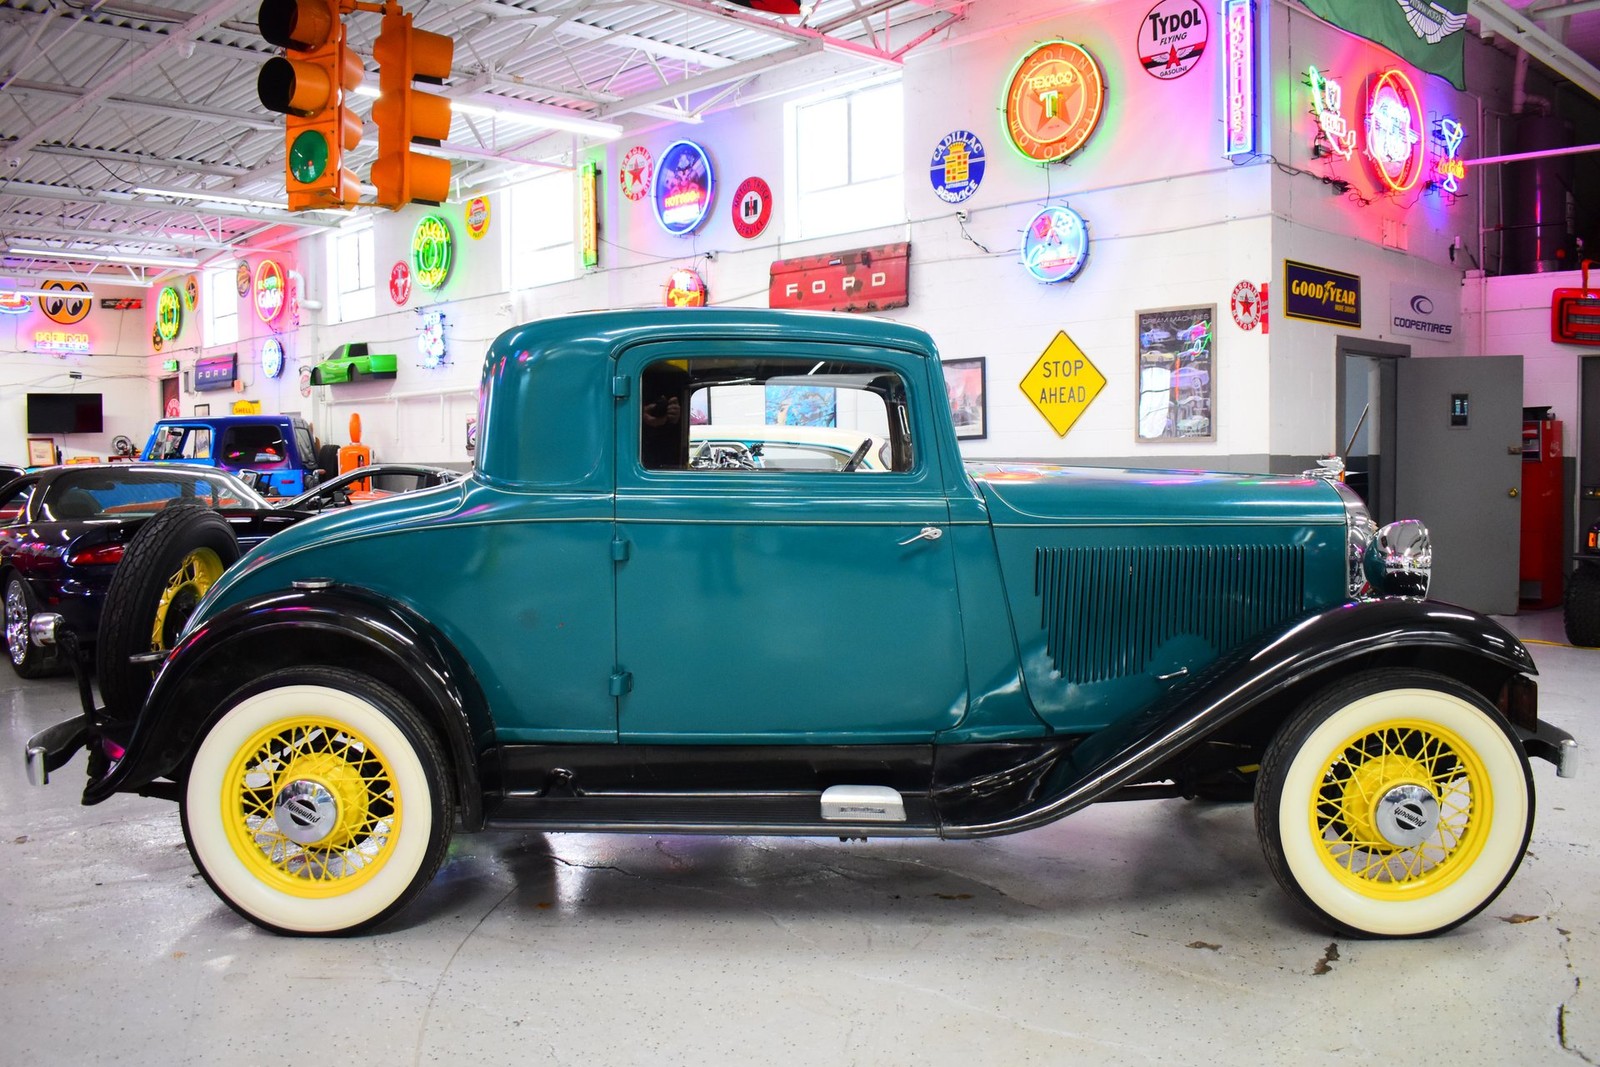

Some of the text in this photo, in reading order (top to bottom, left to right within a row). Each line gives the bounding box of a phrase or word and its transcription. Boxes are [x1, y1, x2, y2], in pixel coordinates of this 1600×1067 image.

[1149, 8, 1201, 41] TYDOL
[1160, 32, 1187, 46] FLYING
[1012, 47, 1097, 101] GASOLINE
[1026, 71, 1074, 90] TEXACO
[1160, 66, 1188, 77] GASOLINE
[1039, 90, 1059, 118] T
[1012, 106, 1097, 158] MOTOR OIL
[933, 131, 982, 161] CADILLAC
[734, 179, 769, 208] MOTOR TRUCK
[936, 179, 978, 202] SERVICE
[738, 221, 764, 234] SERVICE
[786, 272, 886, 297] FORD
[1232, 281, 1261, 300] GASOLINE
[1291, 279, 1356, 305] GOODYEAR
[1142, 313, 1209, 325] DREAM MACHINES
[1232, 309, 1252, 330] MOTOR
[198, 368, 228, 380] FORD
[1042, 359, 1084, 378] STOP
[1039, 386, 1086, 404] AHEAD
[288, 802, 321, 823] Plymouth
[1394, 806, 1427, 827] Plymouth
